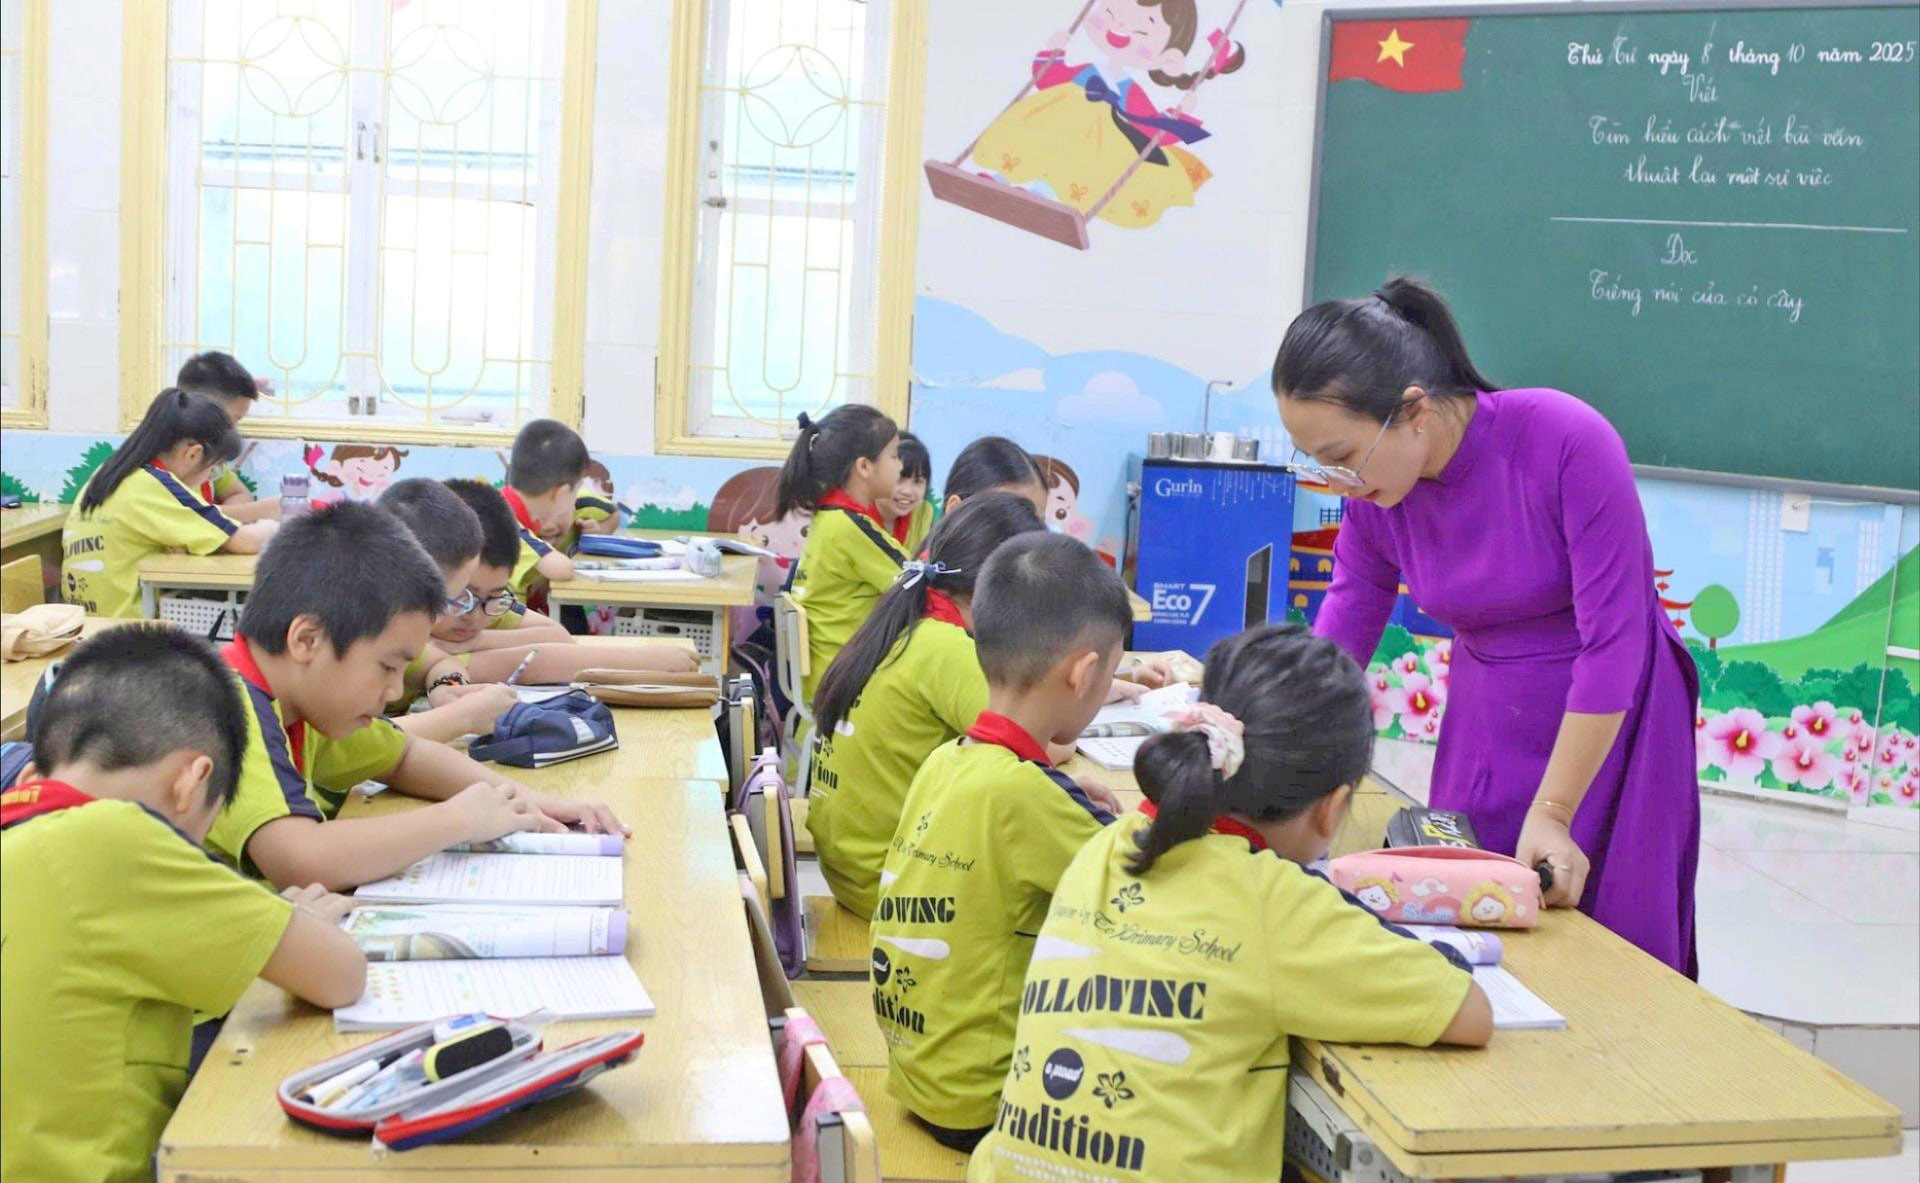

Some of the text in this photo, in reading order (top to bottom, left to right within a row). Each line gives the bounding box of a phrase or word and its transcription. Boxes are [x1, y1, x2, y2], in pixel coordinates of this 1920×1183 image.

[1648, 50, 1690, 76] ngày
[1701, 42, 1714, 64] 8
[1729, 40, 1781, 76] tháng
[1786, 42, 1806, 64] 10
[1817, 47, 1863, 63] năm
[1869, 40, 1917, 63] 2025
[1682, 73, 1720, 103] Viết
[1686, 115, 1731, 144] cách
[1741, 116, 1773, 145] viết
[1823, 127, 1864, 146] văn
[1589, 268, 1643, 317] Tiếng
[1691, 280, 1728, 305] của
[1766, 289, 1806, 324] cây
[1155, 478, 1203, 497] Gurin
[1153, 583, 1217, 626] Eco 7
[938, 850, 976, 871] School
[1109, 923, 1178, 951] Primary
[1178, 928, 1243, 964] School
[872, 986, 925, 1035] dition
[1023, 974, 1206, 1020] OLLOWING
[999, 1094, 1145, 1171] radition
